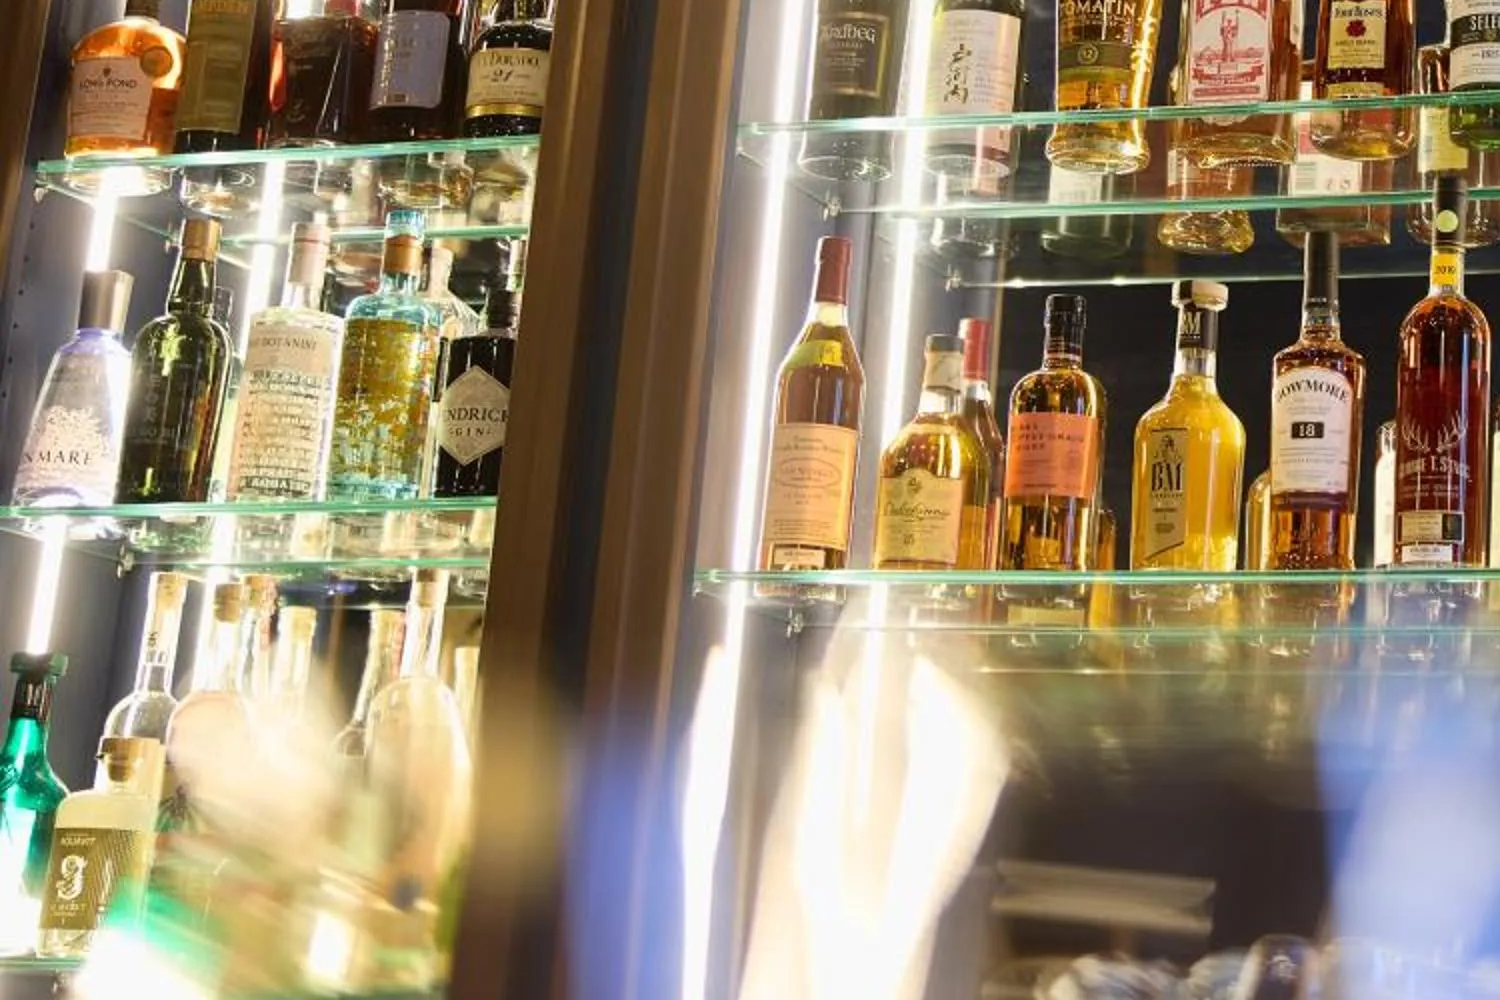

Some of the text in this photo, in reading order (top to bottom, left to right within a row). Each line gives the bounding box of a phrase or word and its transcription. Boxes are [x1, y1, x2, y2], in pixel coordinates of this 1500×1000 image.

[821, 23, 877, 45] Ardbeg
[106, 78, 138, 90] POND
[453, 427, 486, 437] GIN
[1299, 422, 1317, 438] 18
[1151, 463, 1183, 492] BM
